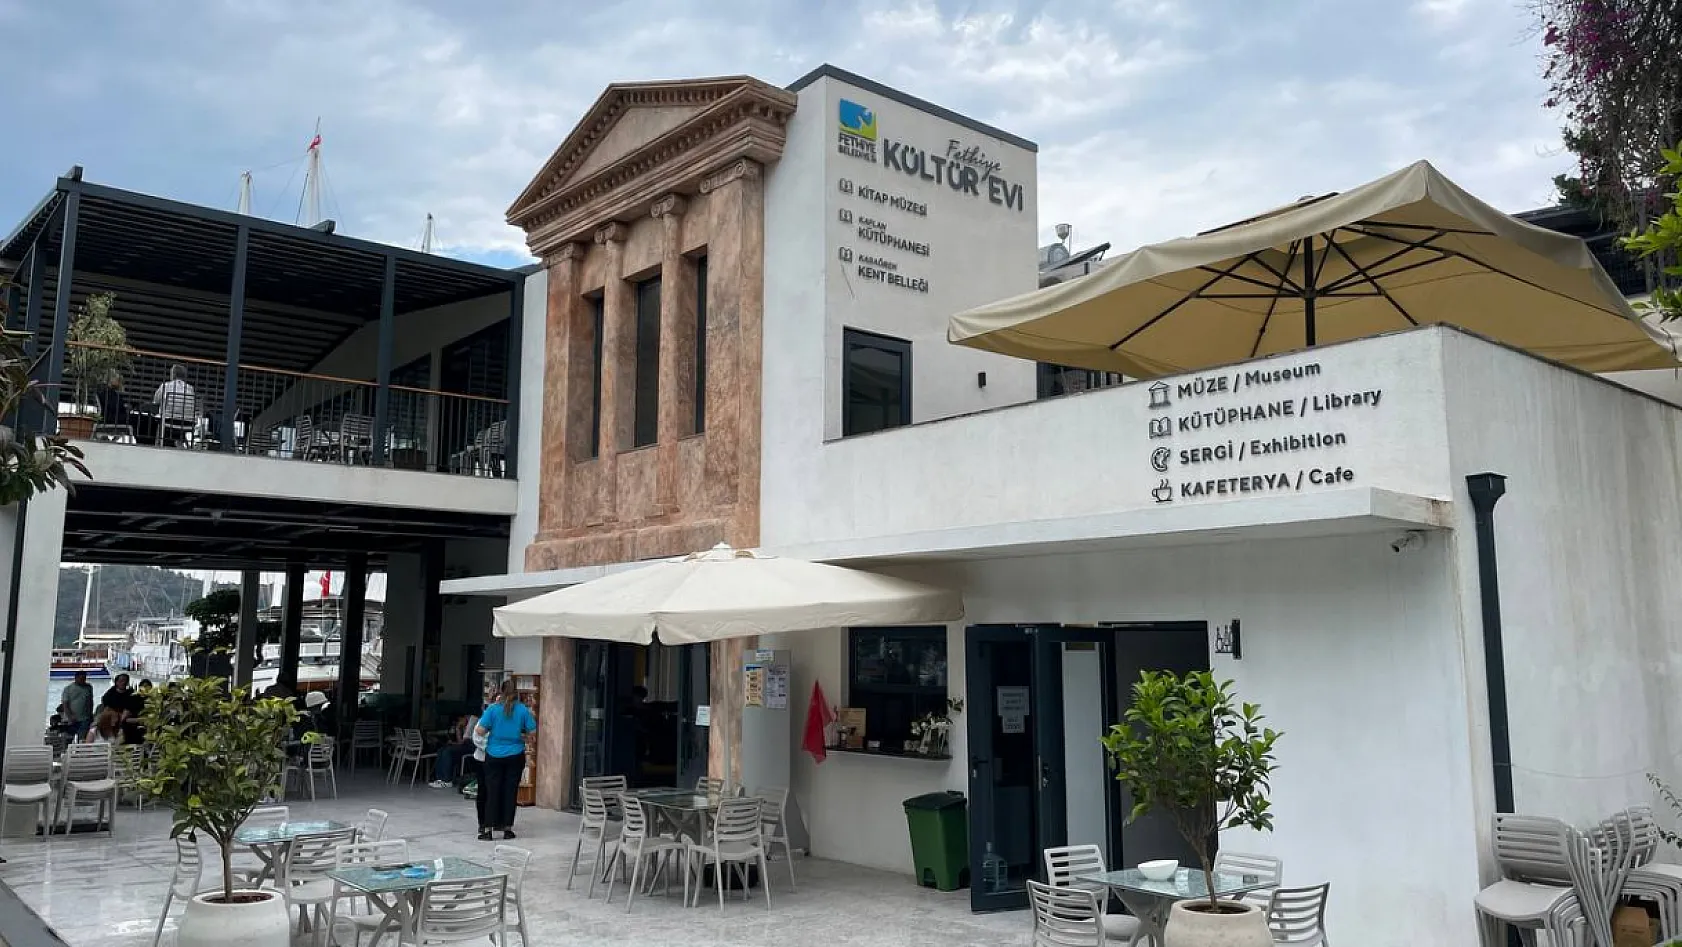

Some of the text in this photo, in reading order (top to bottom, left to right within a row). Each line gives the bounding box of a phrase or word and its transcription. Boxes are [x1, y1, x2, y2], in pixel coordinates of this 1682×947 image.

[883, 137, 979, 196] KÜLTÜR
[946, 139, 1002, 182] Fethiye
[858, 185, 928, 217] KİTAP MÜZESİ
[858, 226, 930, 257] KÜTÜPHANESİ
[858, 264, 929, 294] KENT BELLEĞİ
[1177, 377, 1228, 399] MÜZE
[1245, 363, 1321, 386] Museum
[1178, 399, 1295, 433] KÜTÜPHANE
[1312, 389, 1382, 412] Library
[1180, 439, 1233, 465] SERGİ
[1250, 432, 1346, 455] Exhibition
[1180, 473, 1290, 498] KAFETERYA
[1309, 467, 1354, 484] Cafe
